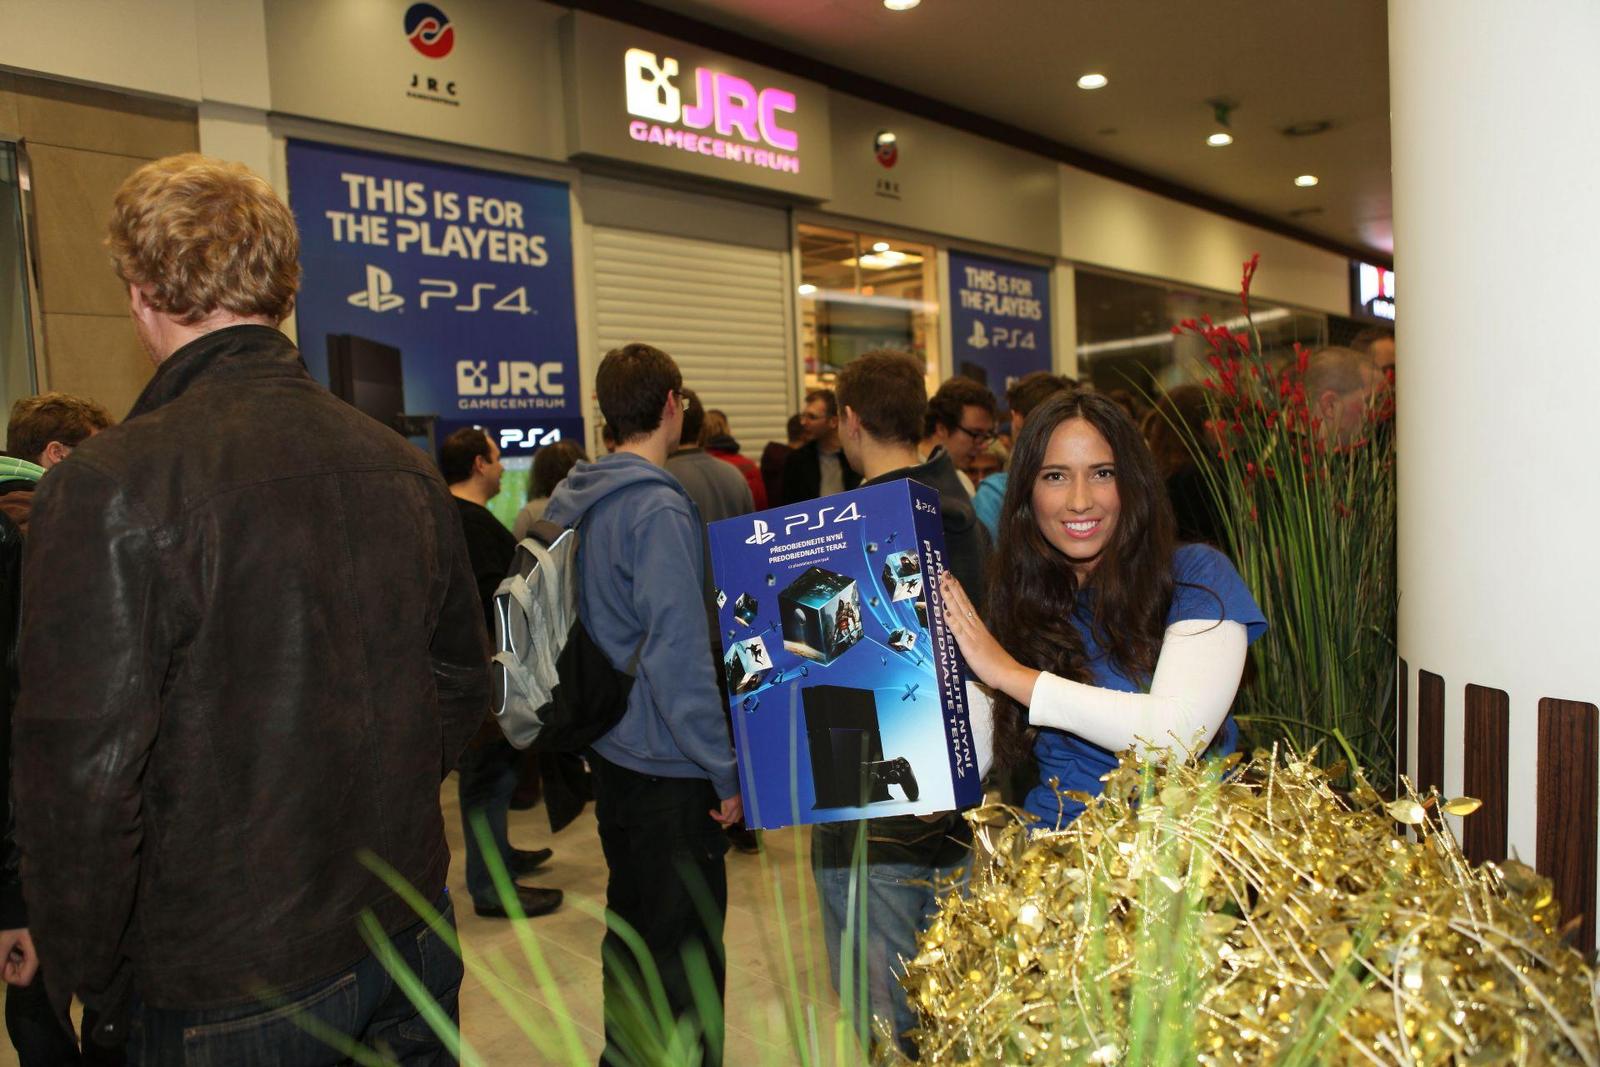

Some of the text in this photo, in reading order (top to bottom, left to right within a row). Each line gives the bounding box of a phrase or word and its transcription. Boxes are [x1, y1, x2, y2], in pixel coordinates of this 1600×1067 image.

[410, 74, 456, 95] JRC
[682, 67, 798, 151] JRC
[629, 121, 800, 174] GAMECENTRUM
[341, 172, 524, 229] THIS IS FOR
[325, 211, 549, 267] THE PLAYERS
[419, 278, 532, 315] PS4
[964, 266, 1033, 297] THIS IS FOR
[959, 288, 1042, 320] THE PLAYERS
[992, 327, 1036, 350] PS4
[490, 361, 565, 395] JRC
[458, 398, 566, 410] GAMECENTRUM
[500, 428, 561, 449] PS4
[784, 502, 861, 535] PS4
[921, 502, 937, 515] PS4
[768, 545, 825, 564] PREDOBJEDNAJTE
[826, 542, 847, 553] TERAZ
[770, 531, 843, 554] PŘEDOBJEDNEJTE NYNÍ
[923, 540, 966, 779] PREDOBJEDNAJTE TERAZ
[959, 720, 973, 769] NYNÍ
